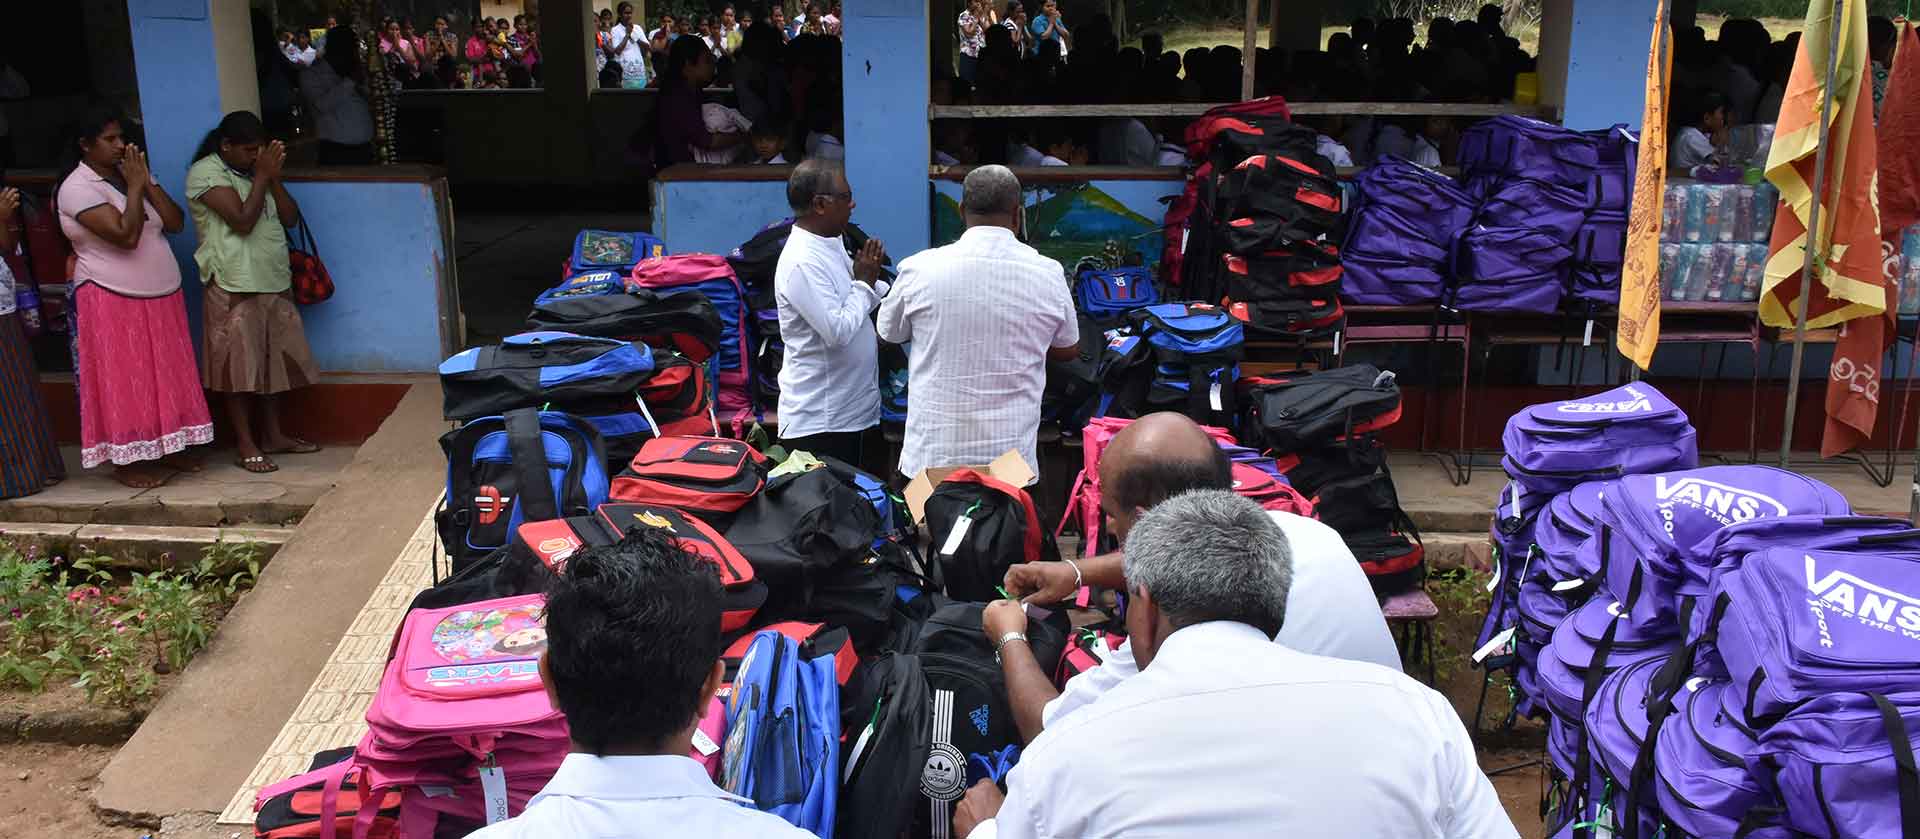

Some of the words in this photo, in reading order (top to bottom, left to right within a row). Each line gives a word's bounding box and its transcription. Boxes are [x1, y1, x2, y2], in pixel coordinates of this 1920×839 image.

[1655, 476, 1789, 523] VANS
[1804, 554, 1920, 632] VANS
[927, 775, 952, 785] adidas
